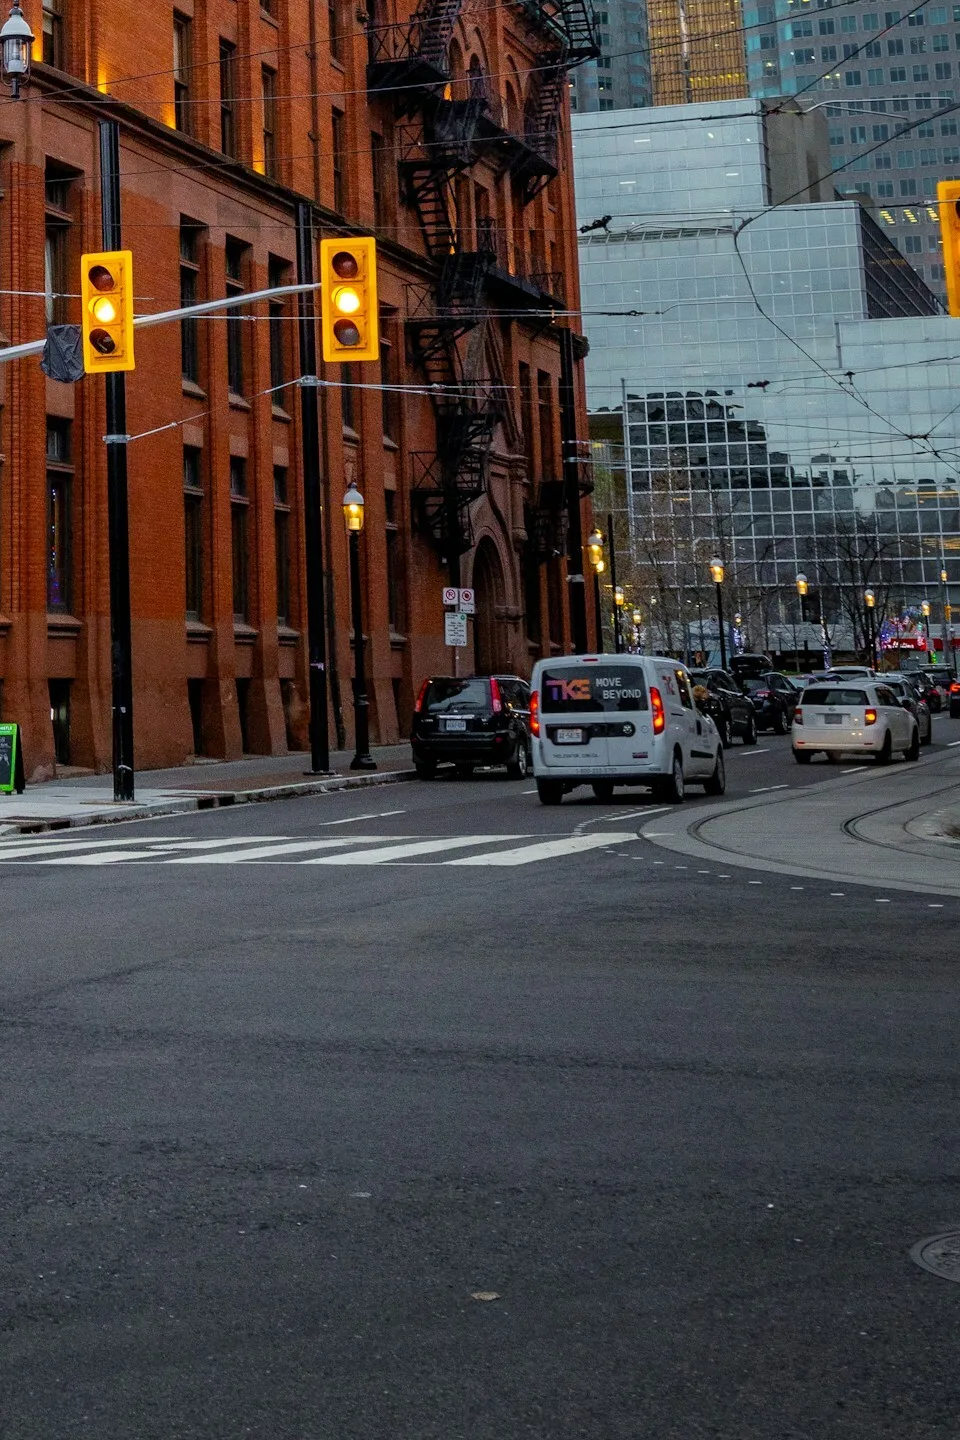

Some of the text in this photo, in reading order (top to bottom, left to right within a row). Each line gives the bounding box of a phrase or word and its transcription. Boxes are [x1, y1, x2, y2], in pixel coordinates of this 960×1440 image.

[595, 678, 622, 688] MOVE
[546, 677, 591, 700] TKE
[602, 689, 642, 699] BEYOND
